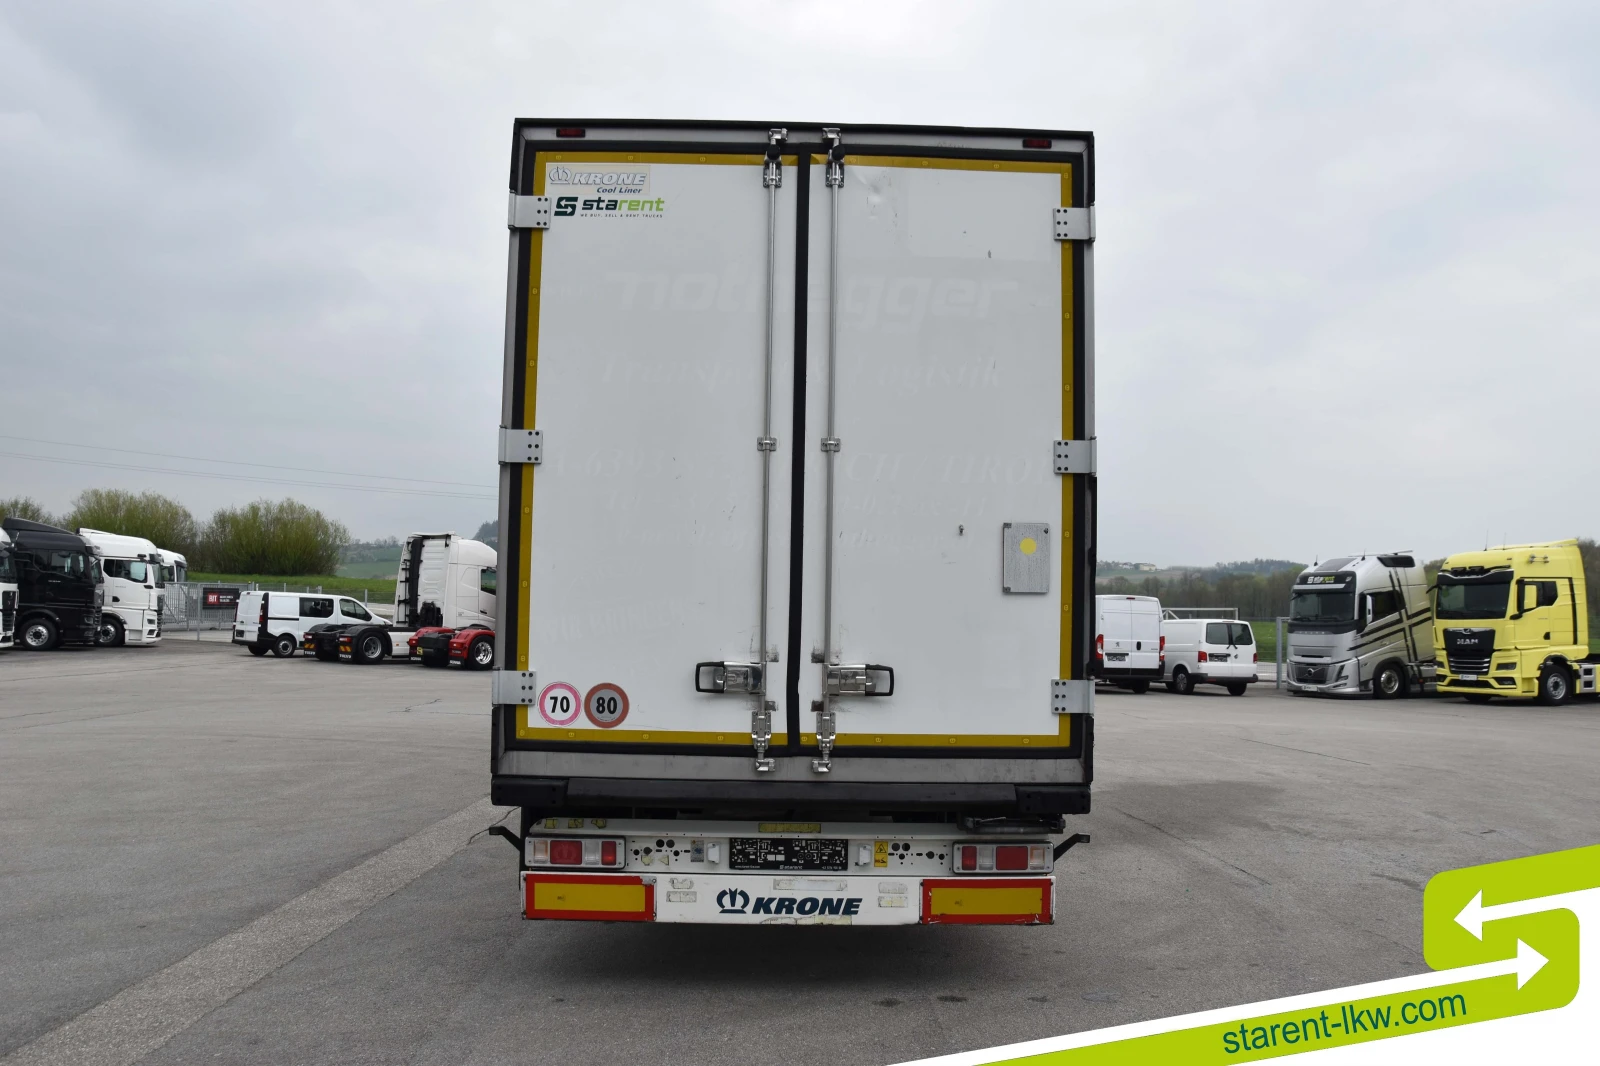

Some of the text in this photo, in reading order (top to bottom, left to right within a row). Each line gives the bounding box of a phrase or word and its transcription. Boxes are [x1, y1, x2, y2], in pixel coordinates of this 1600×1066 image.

[572, 171, 648, 186] KRONE
[596, 186, 643, 194] Cool Liner
[581, 196, 665, 212] starent
[549, 696, 571, 714] 70
[596, 696, 618, 715] 80
[751, 896, 863, 916] KRONE
